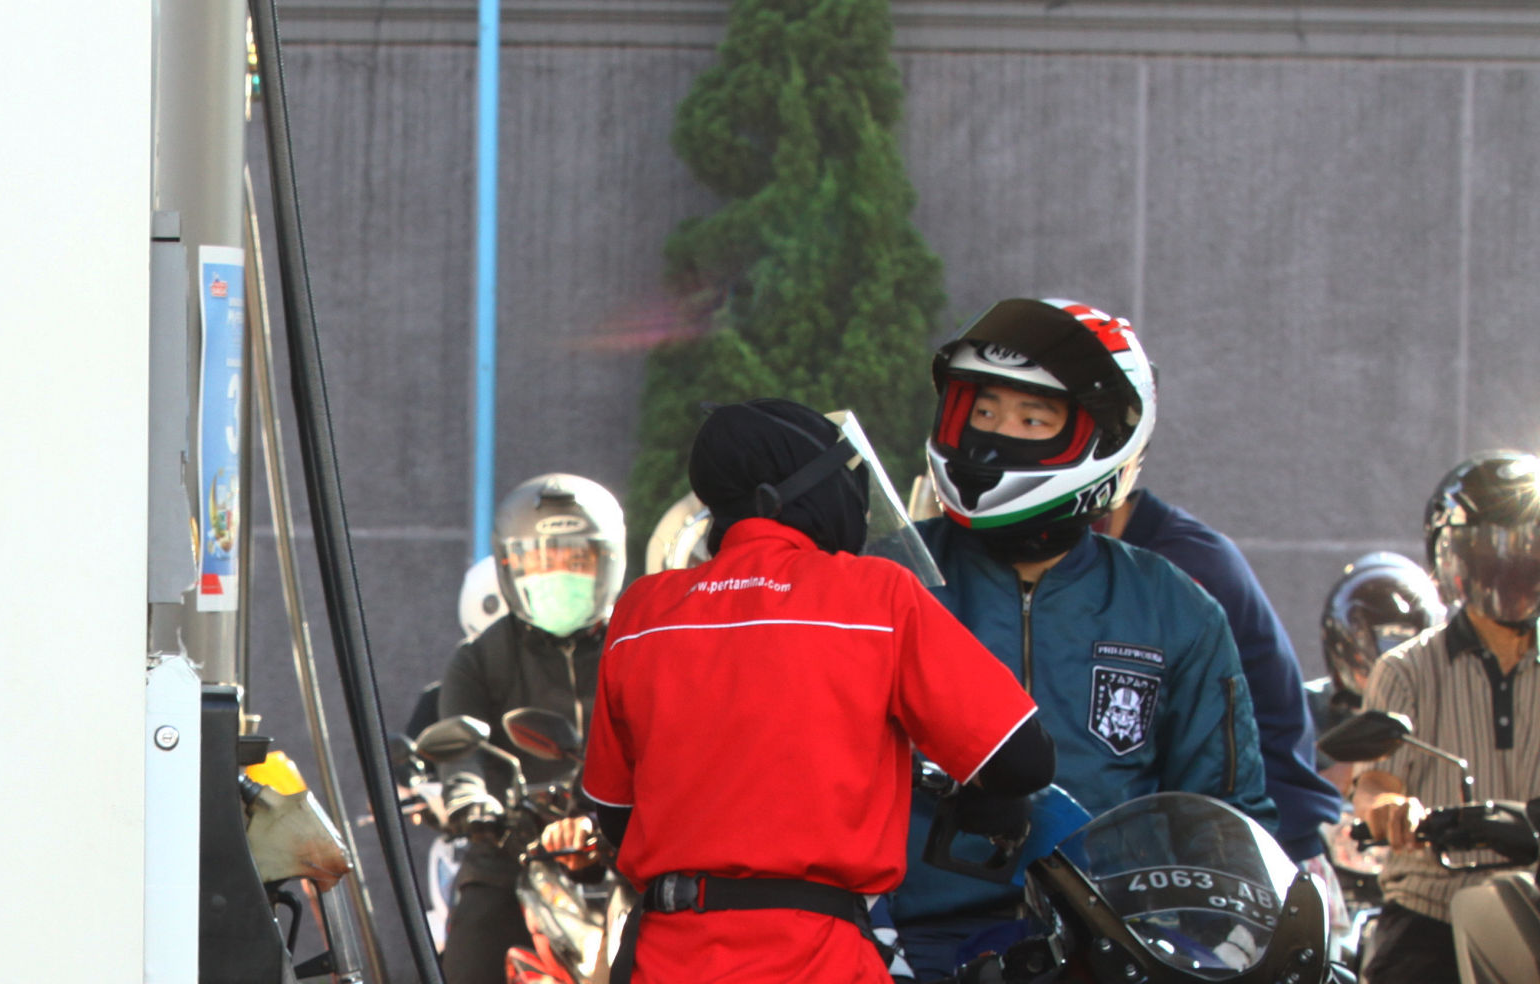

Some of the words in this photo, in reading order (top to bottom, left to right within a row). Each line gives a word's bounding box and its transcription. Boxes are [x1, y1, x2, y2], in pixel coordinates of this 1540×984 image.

[684, 576, 792, 597] w.pertamina.com
[1128, 870, 1214, 892] 4063
[1237, 881, 1273, 909] AB
